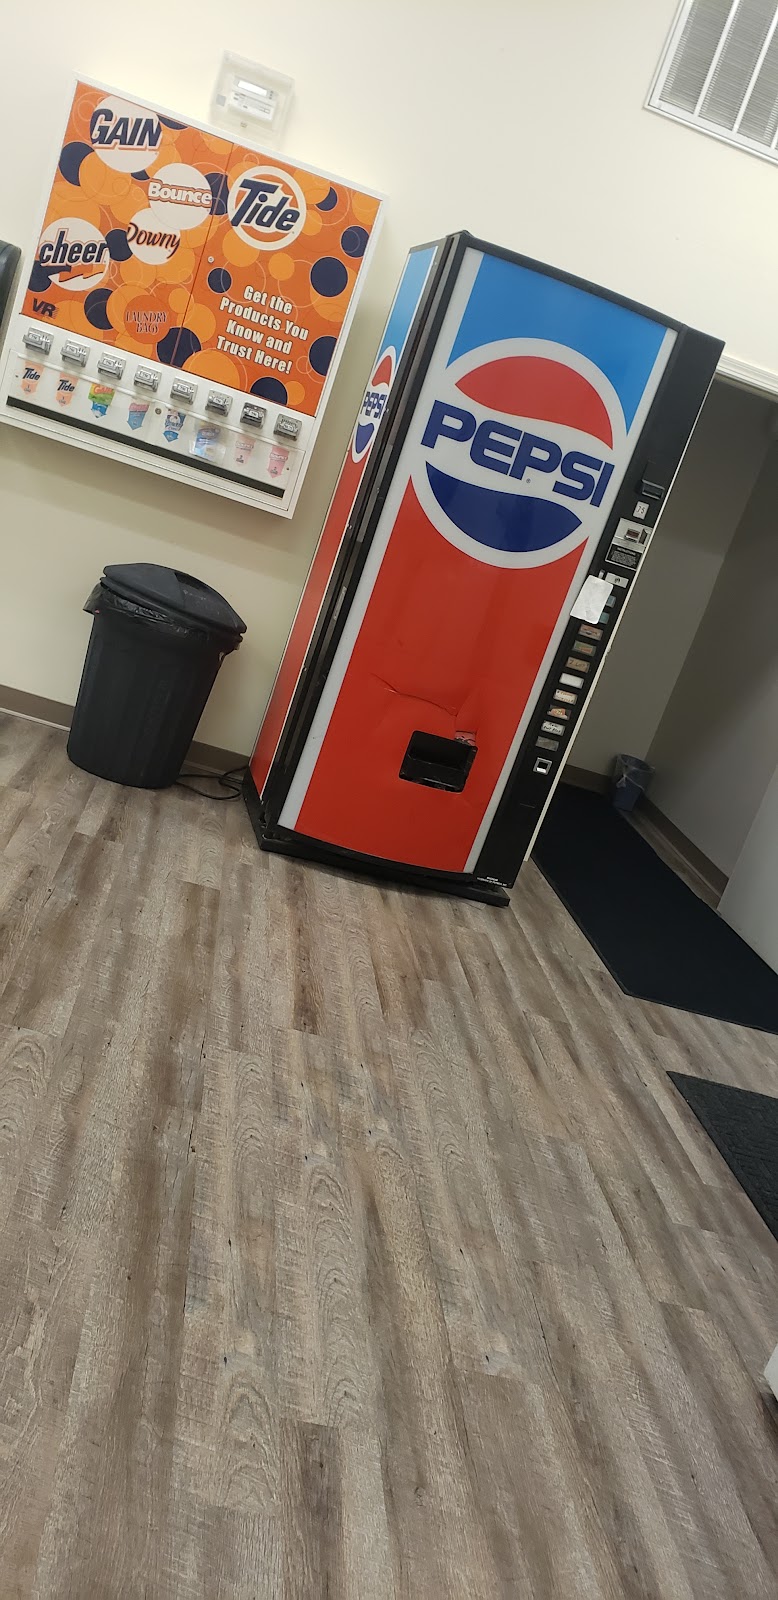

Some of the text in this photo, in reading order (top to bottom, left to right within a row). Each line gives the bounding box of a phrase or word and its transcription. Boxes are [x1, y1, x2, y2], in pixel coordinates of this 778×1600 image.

[90, 108, 163, 147] GAIN
[149, 179, 212, 206] Bounce
[231, 178, 300, 231] Tide
[39, 230, 109, 264] cheer
[127, 222, 180, 259] Downy
[32, 298, 58, 318] VR
[243, 285, 293, 315] Get the
[126, 311, 166, 323] LAUNDRY
[136, 322, 158, 335] BAGS
[219, 296, 309, 341] Products You
[226, 319, 293, 355] Know and
[216, 335, 293, 374] Trust Here!
[22, 367, 41, 380] Tide
[57, 379, 75, 392] Tide
[360, 391, 387, 419] PEPSI
[420, 399, 615, 508] PEPSI
